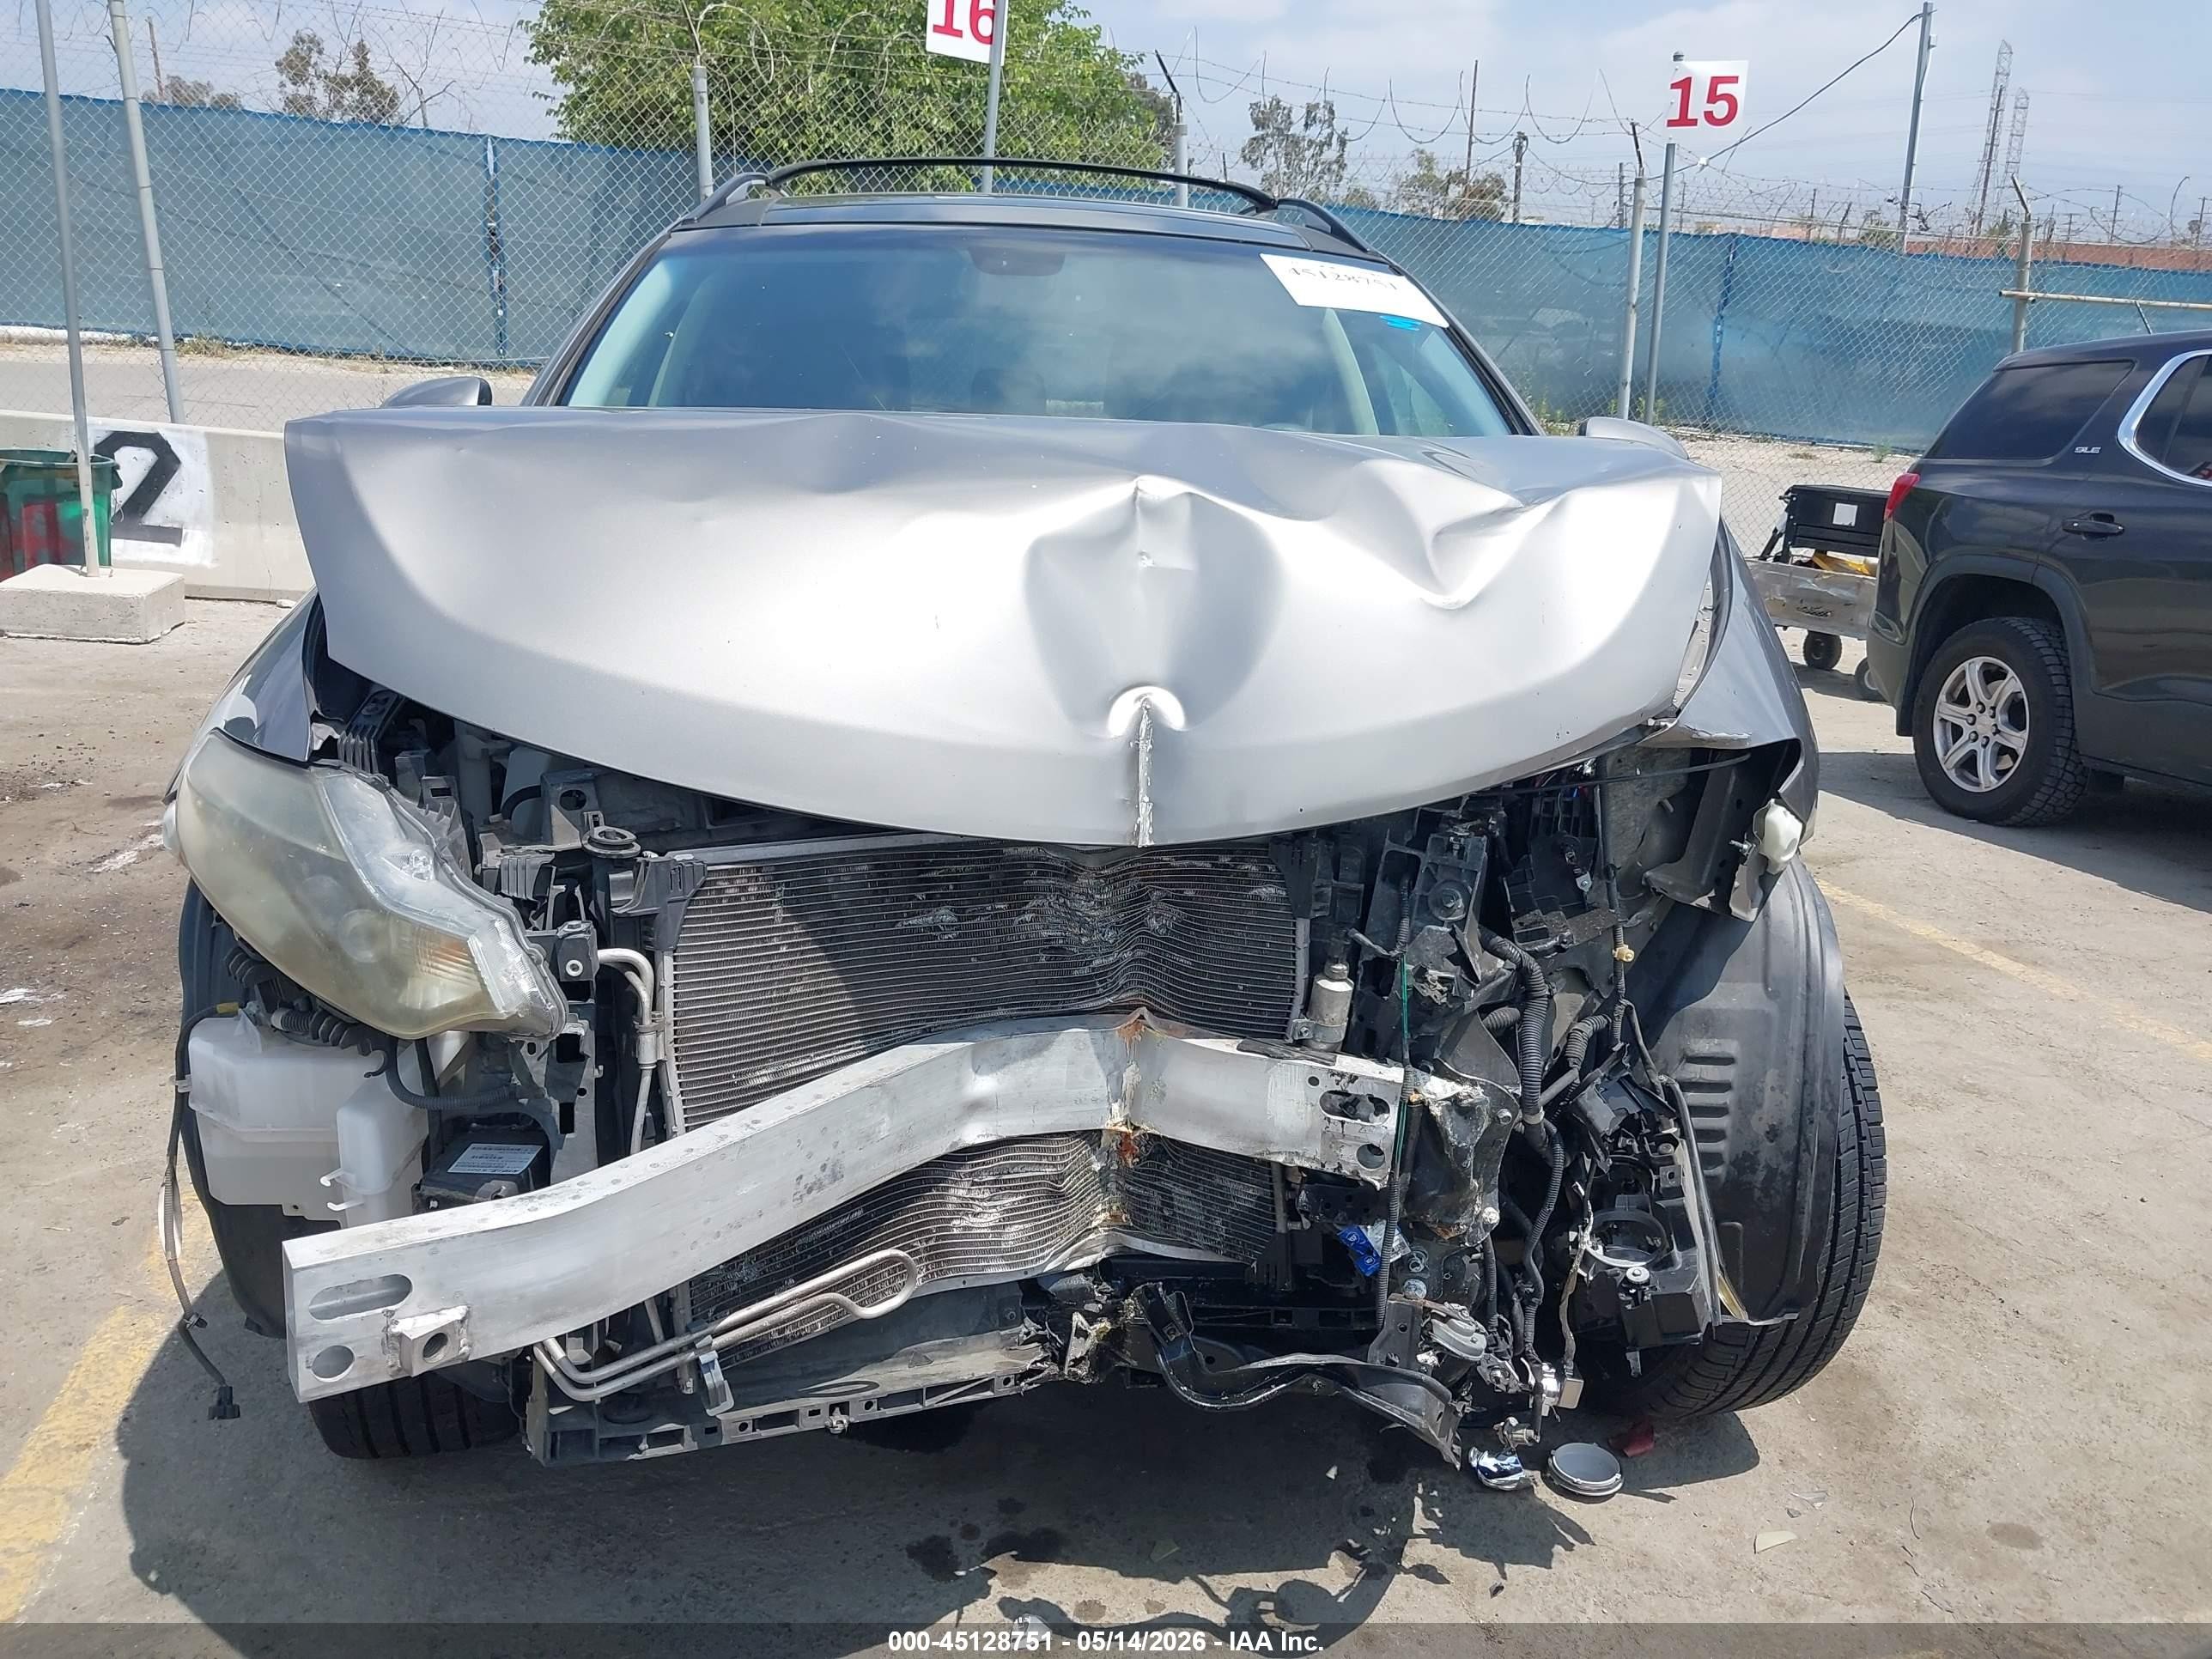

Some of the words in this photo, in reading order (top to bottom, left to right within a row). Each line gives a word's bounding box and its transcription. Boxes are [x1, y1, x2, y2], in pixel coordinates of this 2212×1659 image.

[933, 0, 996, 46] 16
[1666, 75, 1740, 128] 15
[94, 430, 182, 547] 2
